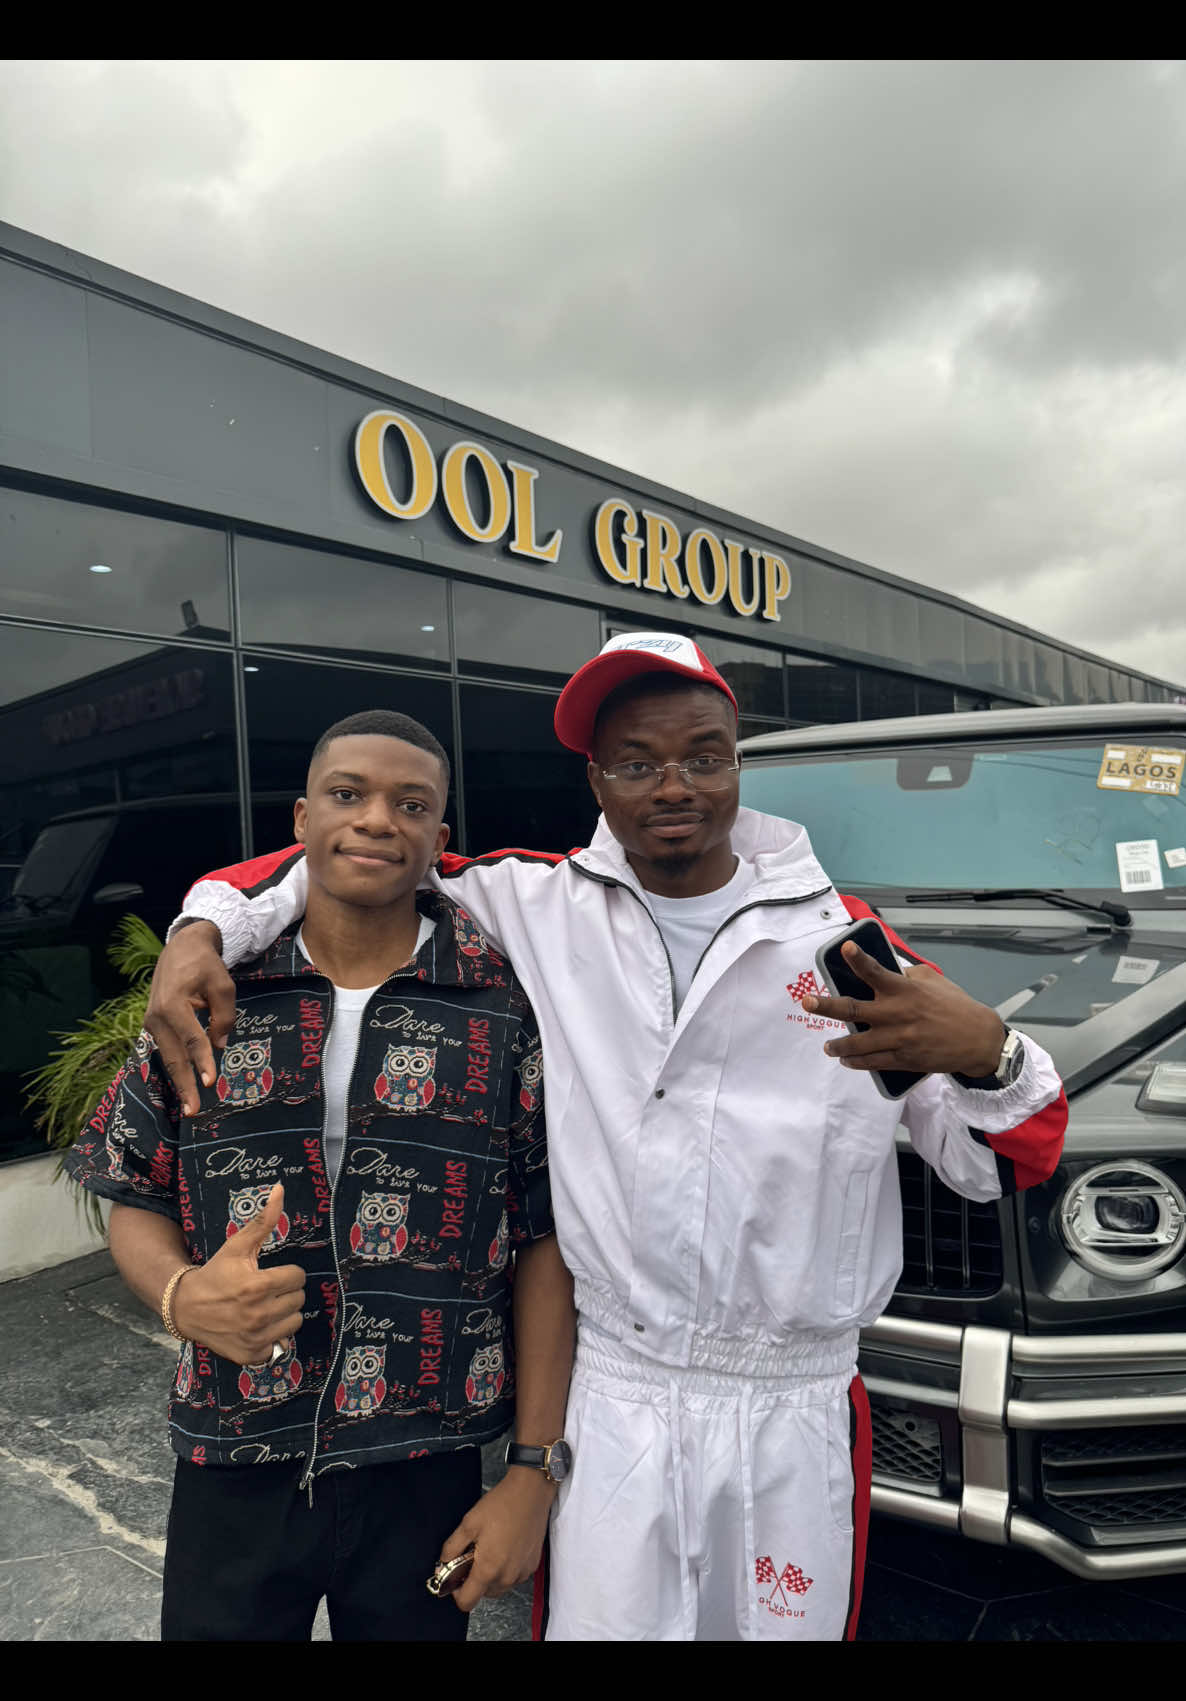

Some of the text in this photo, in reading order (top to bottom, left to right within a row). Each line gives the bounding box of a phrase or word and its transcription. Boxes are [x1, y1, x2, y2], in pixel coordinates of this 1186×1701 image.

[355, 410, 792, 622] OOL GROUP
[1106, 761, 1177, 779] LAGOS
[299, 998, 325, 1069] DREAMS
[370, 1003, 446, 1034] Dare
[787, 1014, 846, 1030] HIGH VOGUE
[464, 1017, 491, 1095] DREAMS
[204, 1146, 284, 1178] Dare
[303, 1136, 331, 1213] DREAMS
[346, 1146, 420, 1179] Dare
[437, 1159, 469, 1240] DREAMS
[416, 1307, 445, 1387] DREAMS
